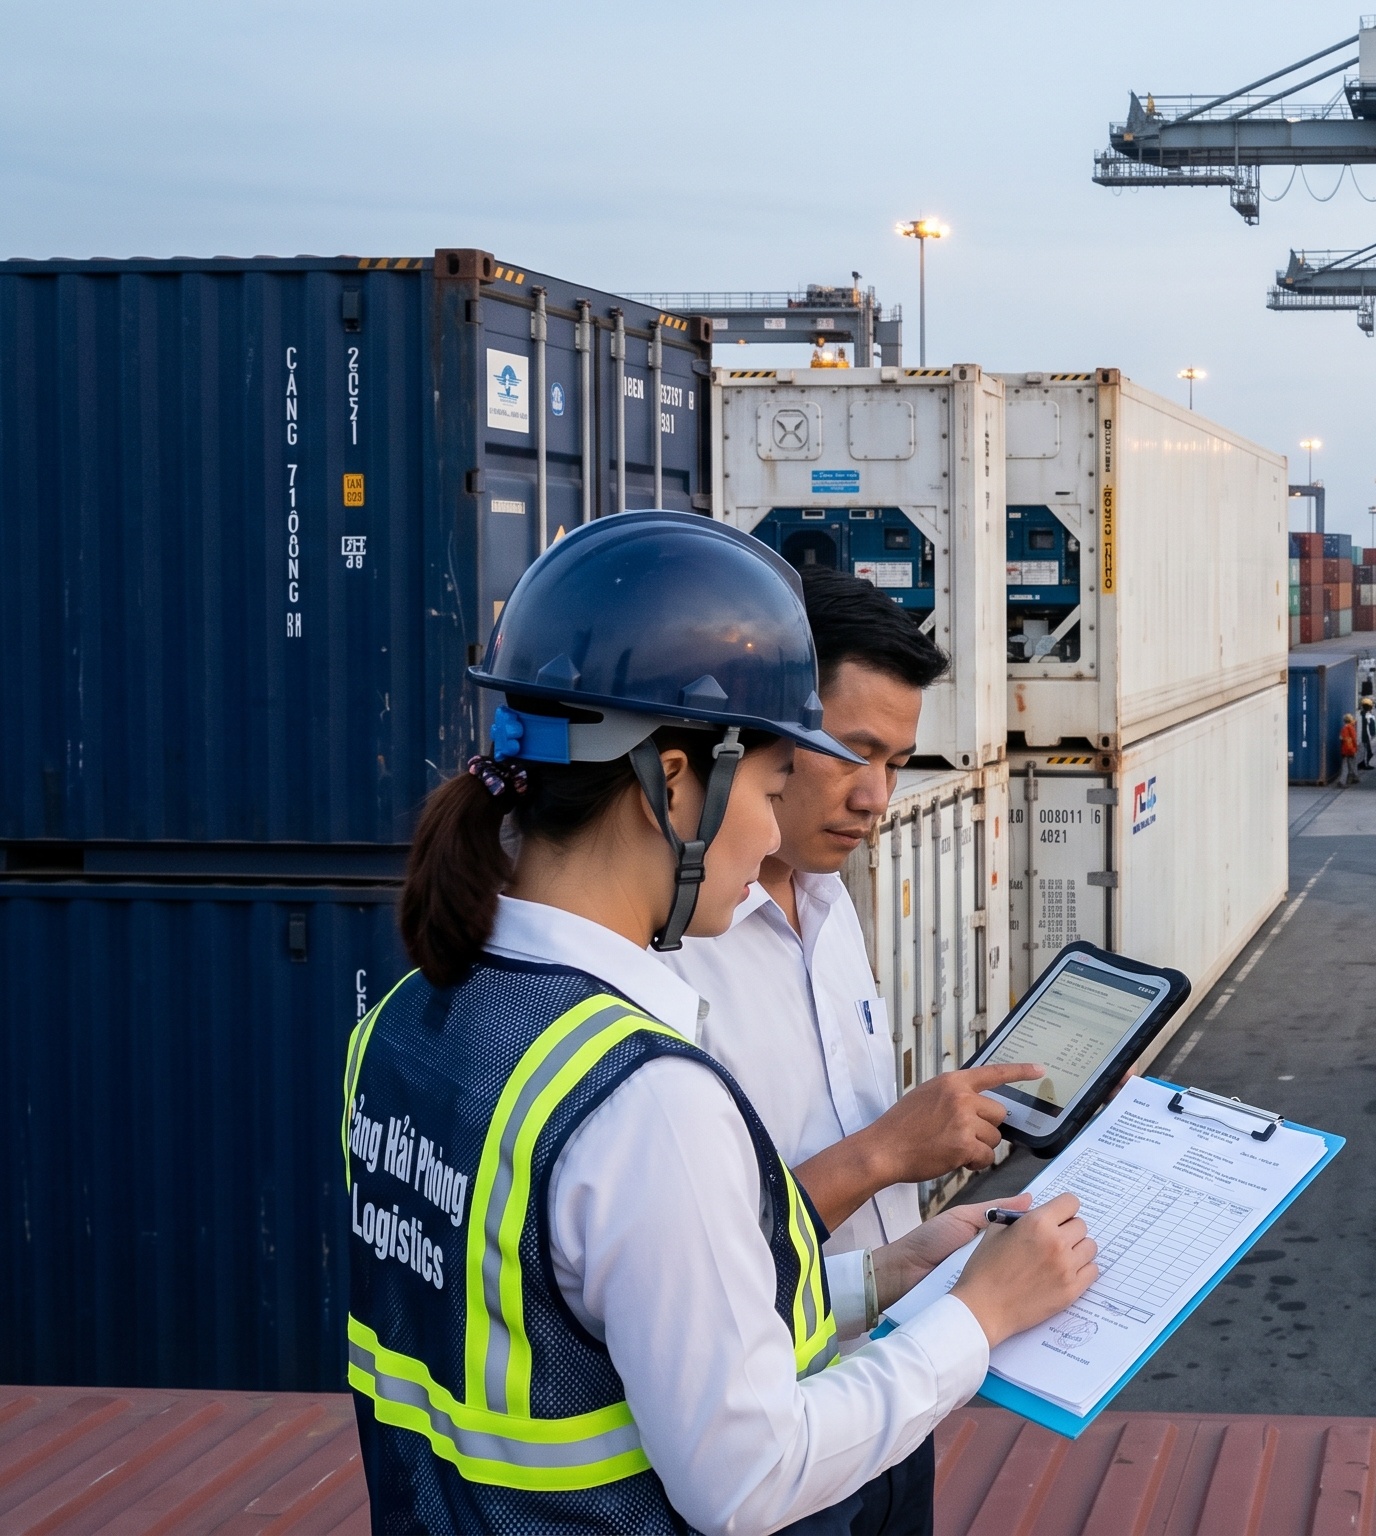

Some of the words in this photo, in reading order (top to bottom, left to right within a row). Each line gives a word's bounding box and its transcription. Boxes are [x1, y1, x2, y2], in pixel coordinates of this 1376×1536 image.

[1039, 809, 1082, 824] 008011
[384, 1115, 416, 1183] Hải
[352, 1182, 444, 1290] Logistics
